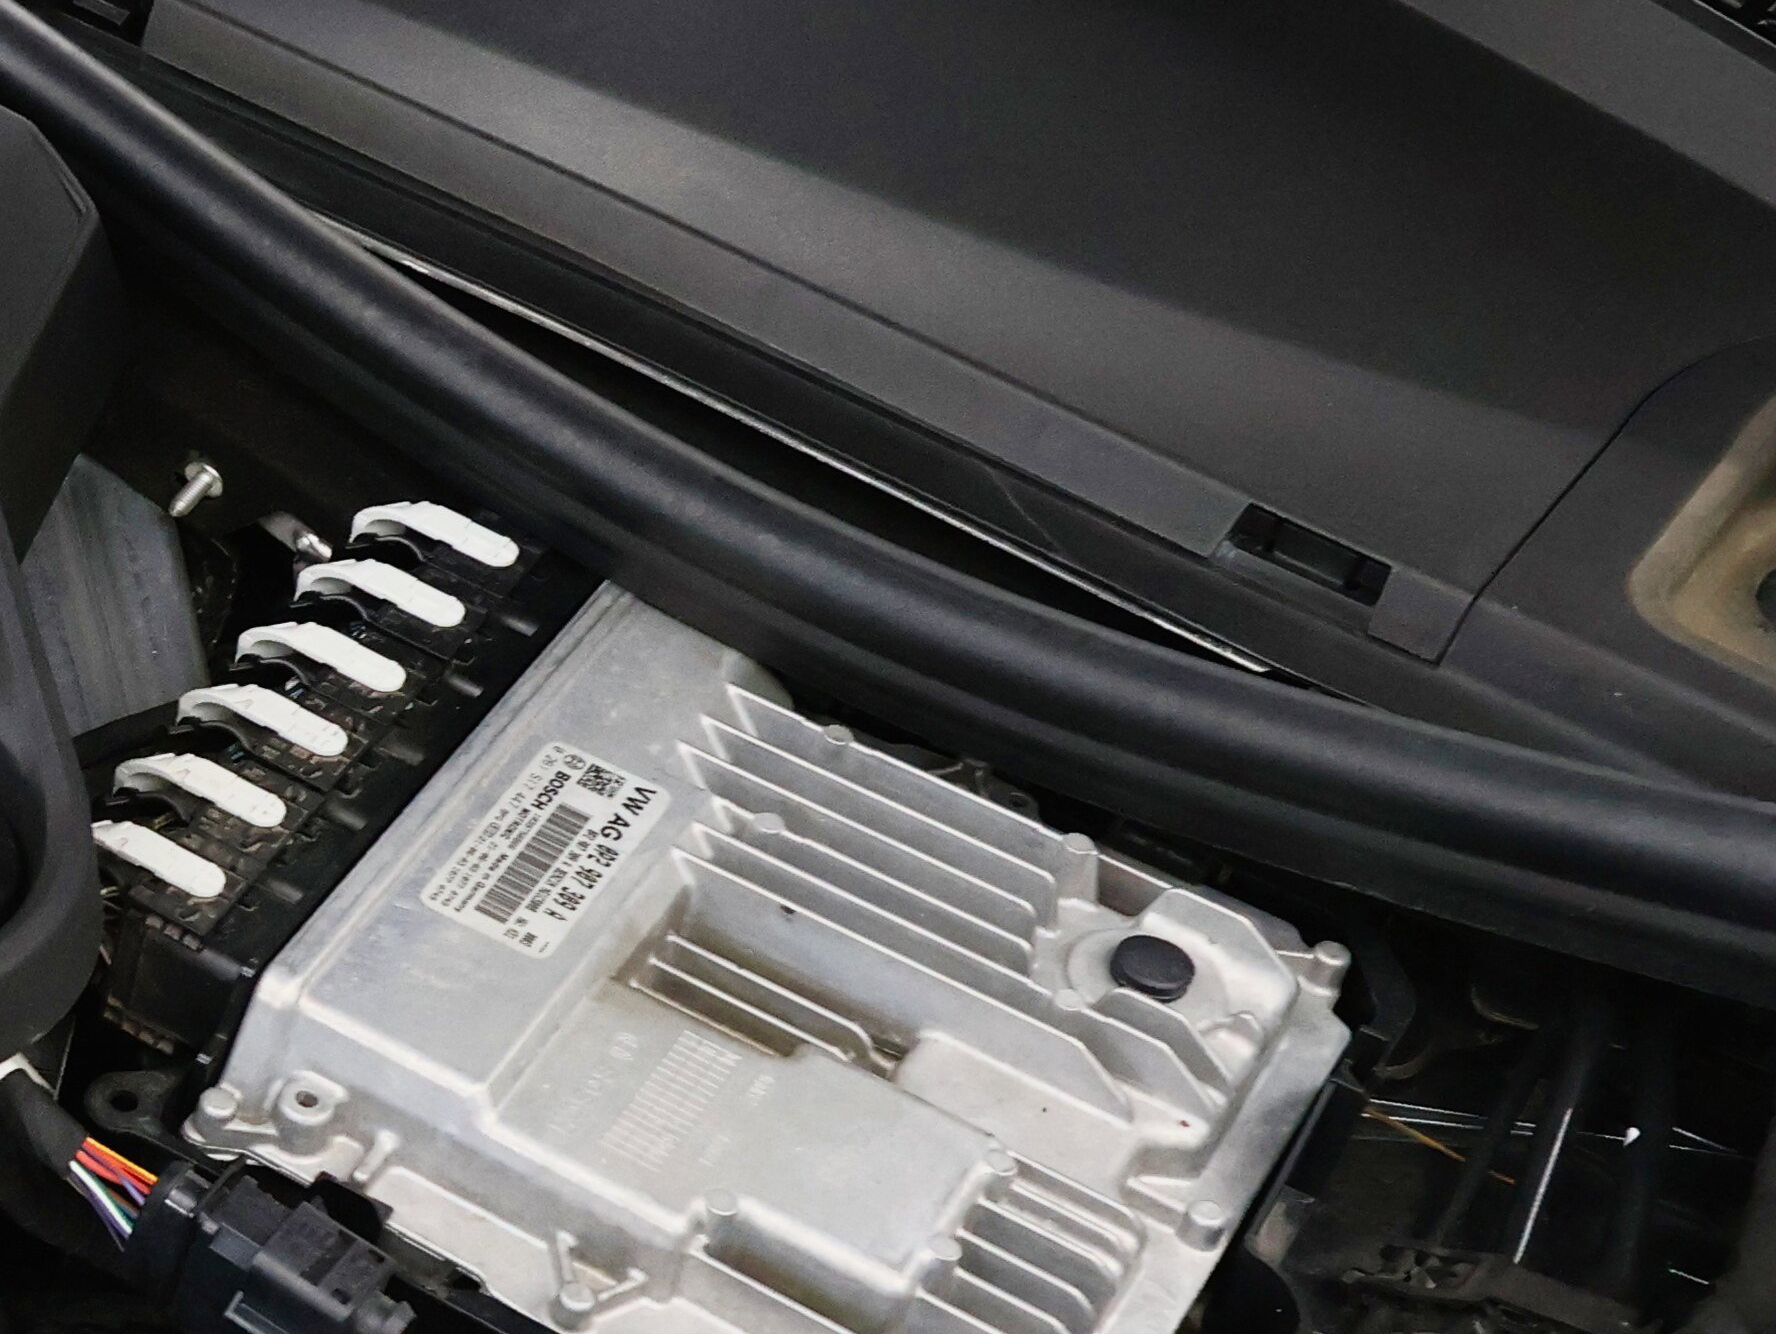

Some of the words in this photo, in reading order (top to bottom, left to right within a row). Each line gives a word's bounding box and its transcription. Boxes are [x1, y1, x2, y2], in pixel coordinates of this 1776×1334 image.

[530, 770, 570, 811] BOSCH
[621, 787, 656, 817] VW
[598, 813, 630, 843] AG
